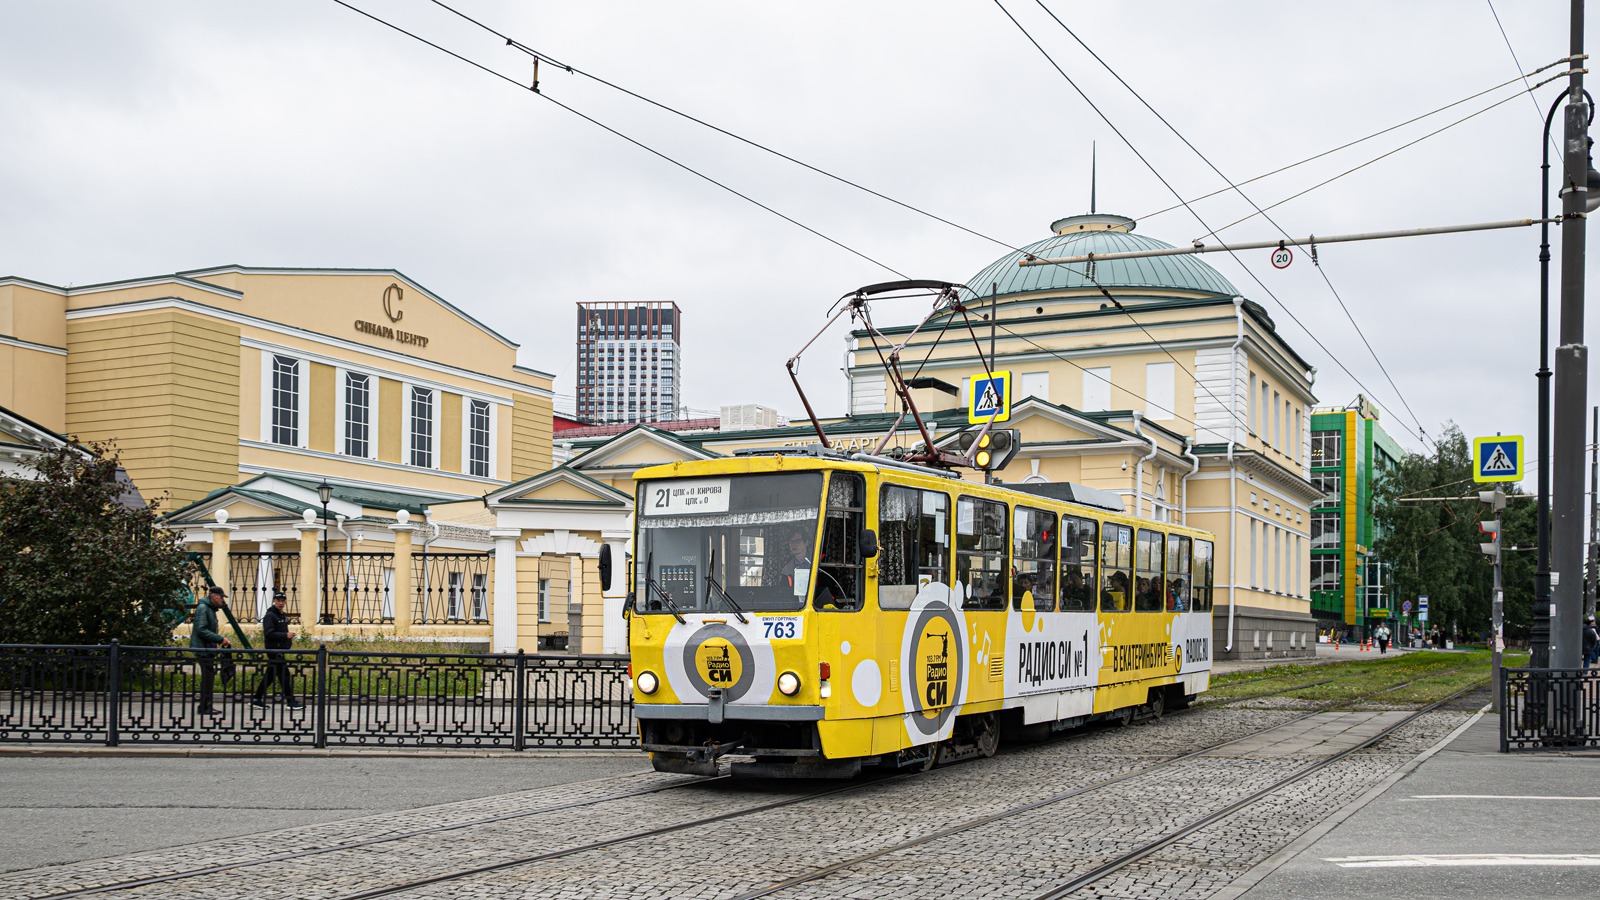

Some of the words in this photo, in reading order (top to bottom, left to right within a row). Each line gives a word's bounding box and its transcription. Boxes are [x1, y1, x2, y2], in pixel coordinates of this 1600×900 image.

[1276, 253, 1288, 263] 20
[354, 319, 394, 340] СИНАРА
[396, 329, 429, 347] ЦЕНТР
[848, 437, 878, 450] АРТ
[655, 488, 670, 508] 21
[672, 488, 686, 497] ЦПК
[685, 497, 698, 506] ЦПК
[1119, 530, 1128, 545] 763
[763, 621, 796, 639] 763
[1018, 641, 1056, 687] РАДИО
[1058, 640, 1072, 680] СИ
[1113, 645, 1119, 672] В
[1119, 642, 1168, 672] ЕКАТЕРИНБУРГЕ
[707, 661, 730, 669] Радио
[927, 665, 947, 680] Радио
[708, 670, 732, 682] СИ
[926, 681, 948, 707] СИ
